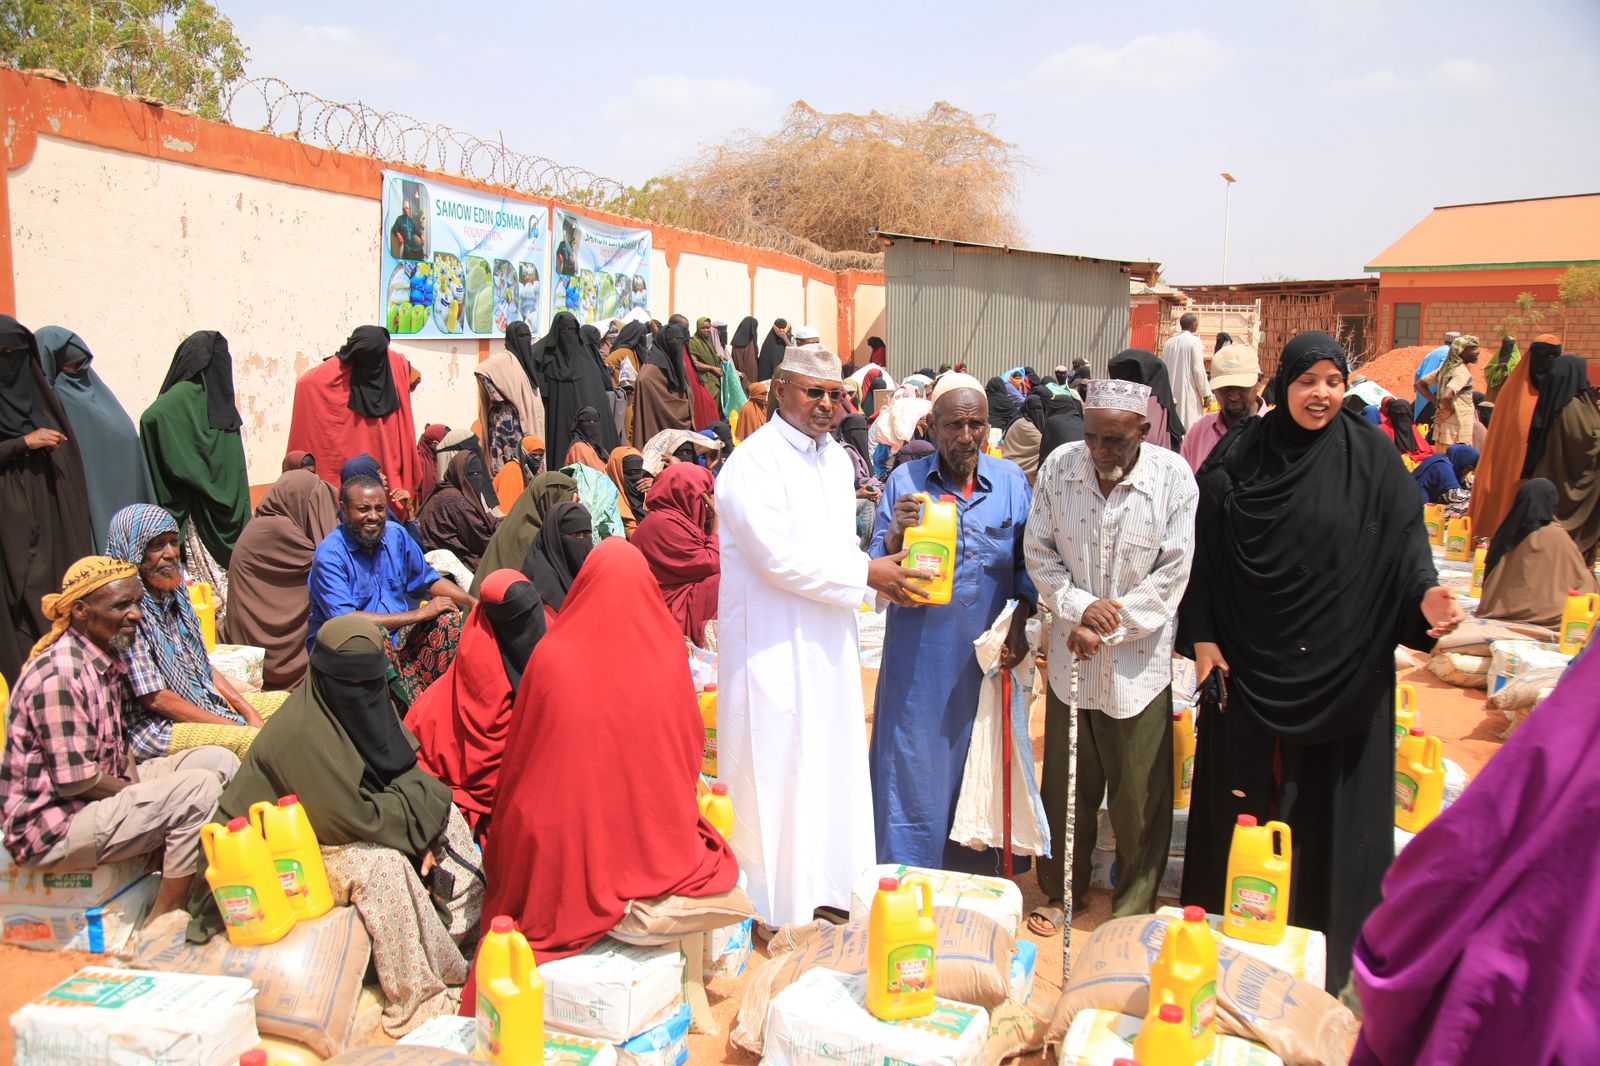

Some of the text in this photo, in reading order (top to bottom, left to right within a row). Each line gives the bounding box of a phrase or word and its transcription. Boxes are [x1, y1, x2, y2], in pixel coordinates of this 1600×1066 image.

[435, 199, 525, 231] SAMOW EDIN OSMAN
